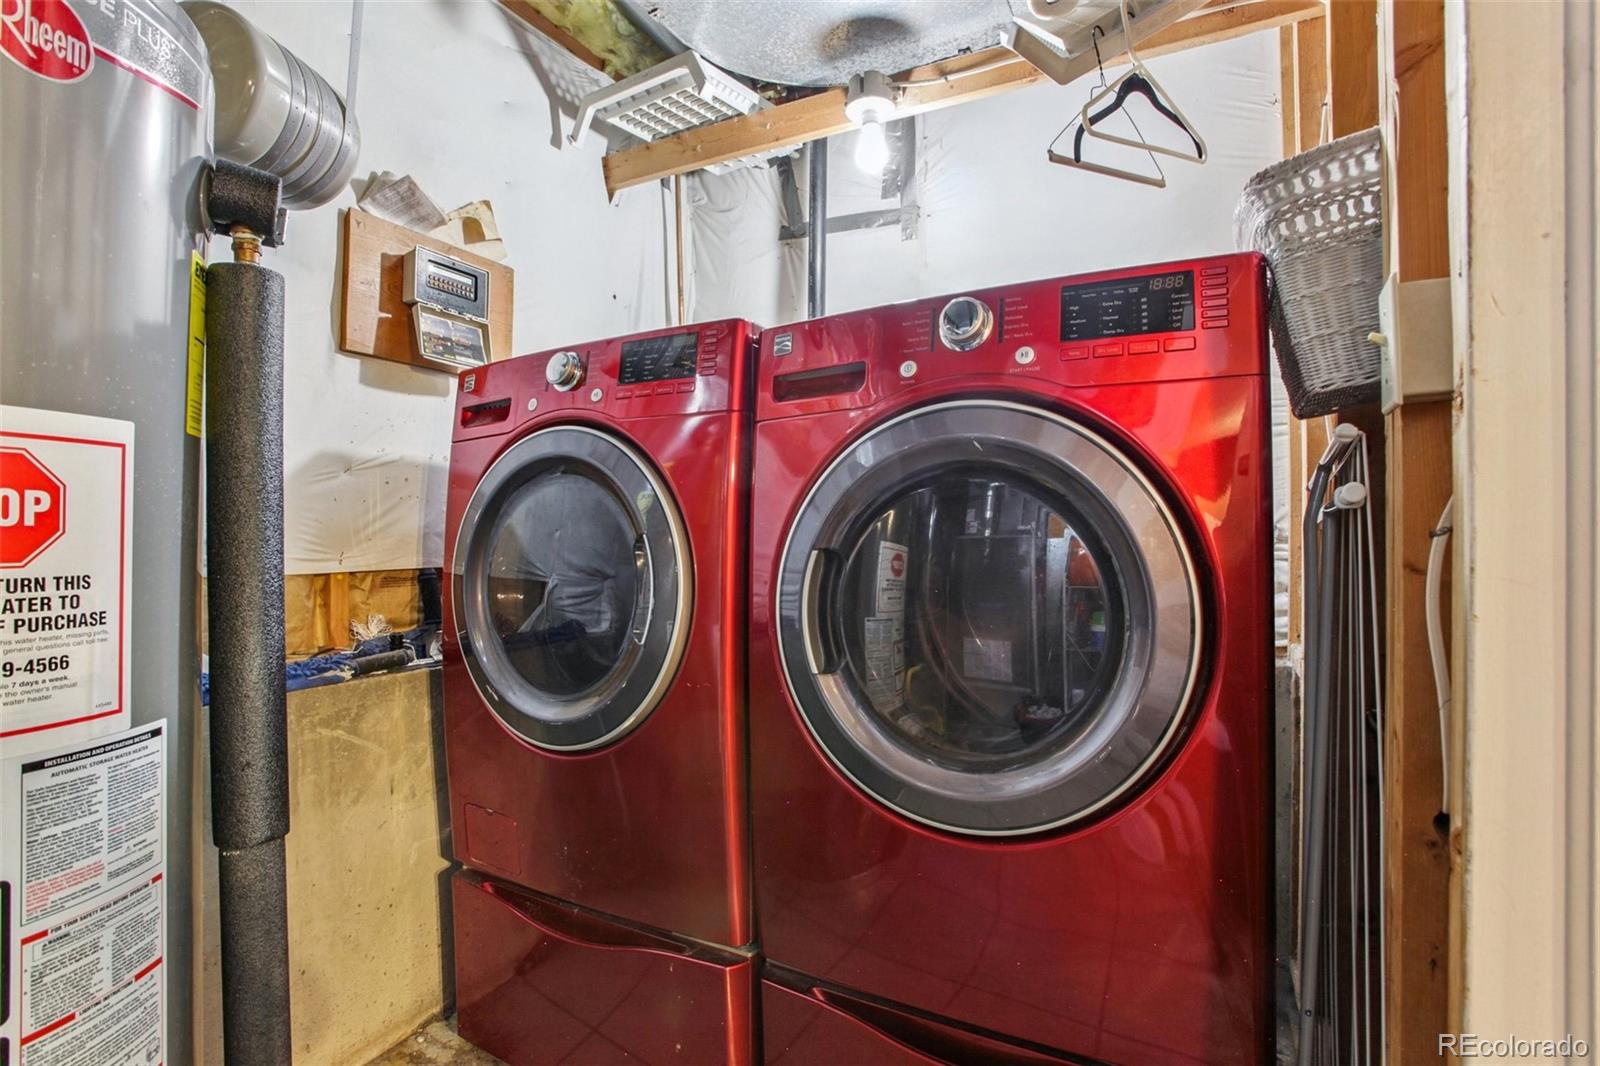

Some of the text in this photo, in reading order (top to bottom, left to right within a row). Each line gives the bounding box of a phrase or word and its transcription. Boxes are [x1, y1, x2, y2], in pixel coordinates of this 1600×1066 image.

[0, 0, 86, 70] Rheem
[124, 8, 171, 59] PLUS
[0, 488, 51, 527] OP
[53, 575, 91, 591] THIS
[2, 594, 80, 614] ATER TO
[13, 611, 107, 634] PURCHASE
[15, 637, 37, 645] water
[66, 631, 92, 641] missing
[3, 646, 33, 656] general
[35, 641, 71, 652] questions
[2, 655, 70, 678] 9-4566
[19, 679, 39, 690] days
[20, 686, 50, 697] owner's
[51, 681, 78, 692] manual
[2, 699, 25, 707] water
[44, 750, 91, 768] INSTALLATION
[92, 747, 105, 756] AND
[50, 763, 88, 778] AUTOMATIC
[89, 756, 114, 769] STORAGE
